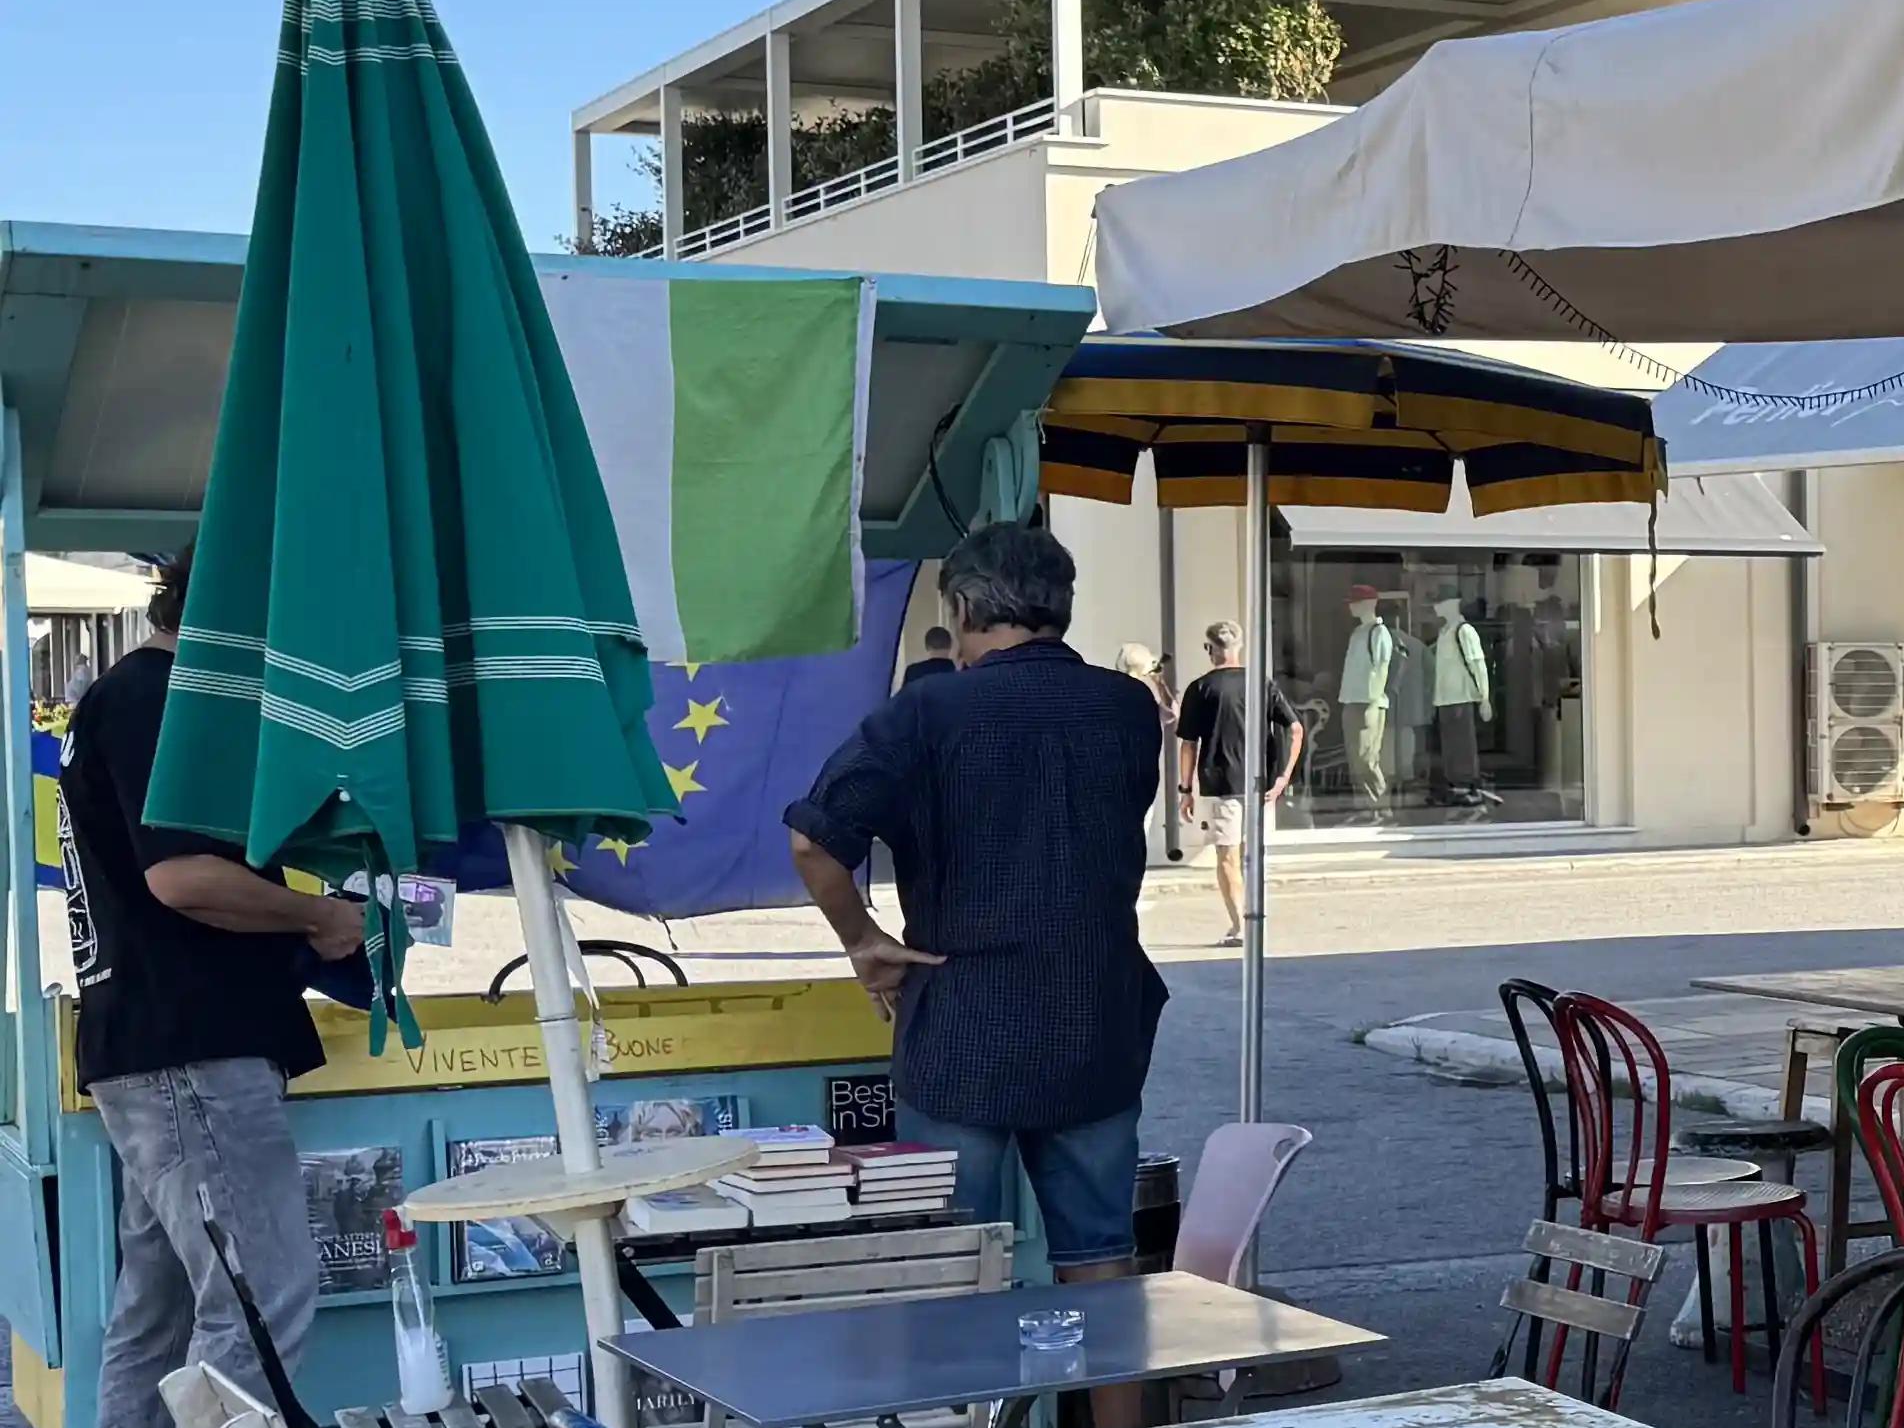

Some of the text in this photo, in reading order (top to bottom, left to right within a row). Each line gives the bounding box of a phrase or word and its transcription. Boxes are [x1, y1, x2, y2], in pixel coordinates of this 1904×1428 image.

[405, 1032, 542, 1075] VIVENTE
[830, 1079, 897, 1106] Best
[831, 1107, 857, 1131] in
